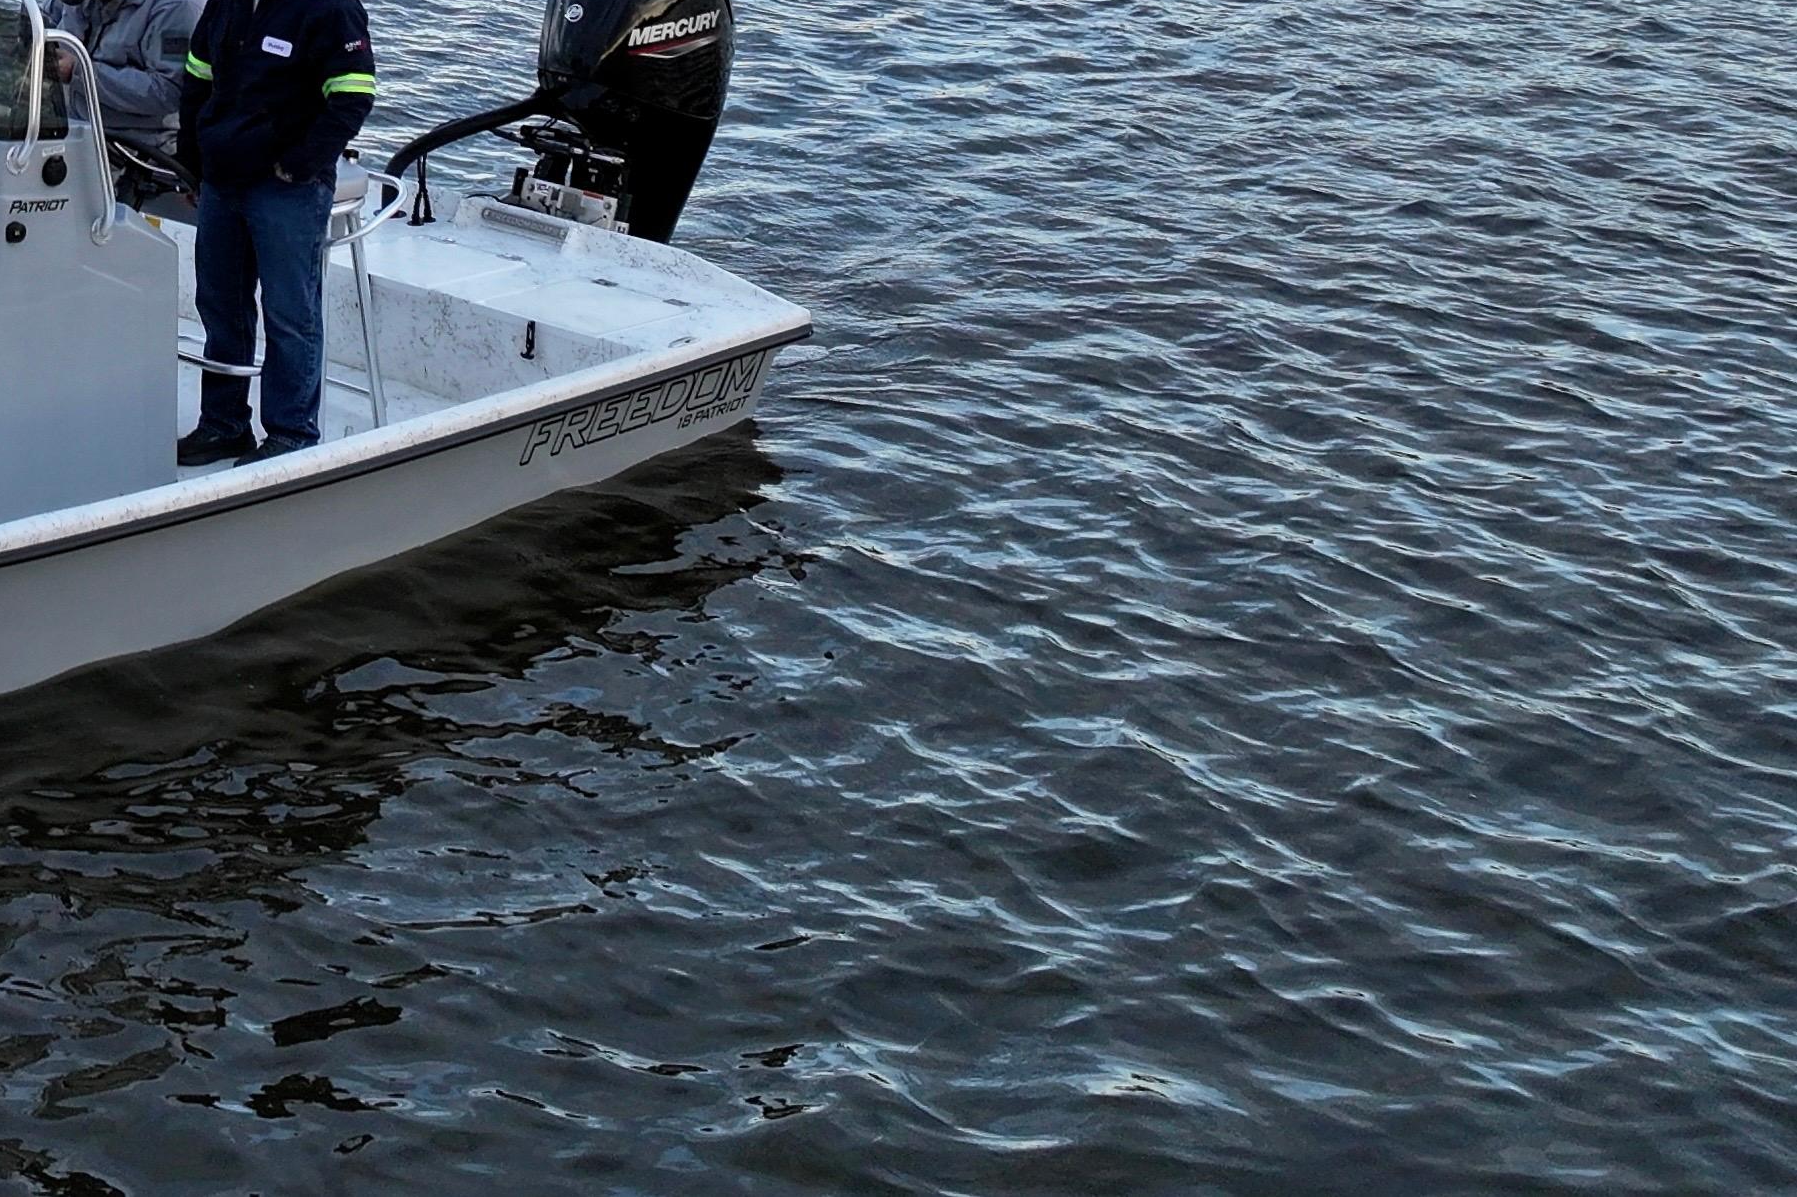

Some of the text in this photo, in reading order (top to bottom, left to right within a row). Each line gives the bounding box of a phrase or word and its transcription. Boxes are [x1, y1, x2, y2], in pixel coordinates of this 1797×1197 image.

[628, 10, 721, 47] MERCURY
[9, 199, 70, 214] PATRIOT
[519, 348, 769, 466] FREEDOM
[693, 394, 751, 424] PATRIOT
